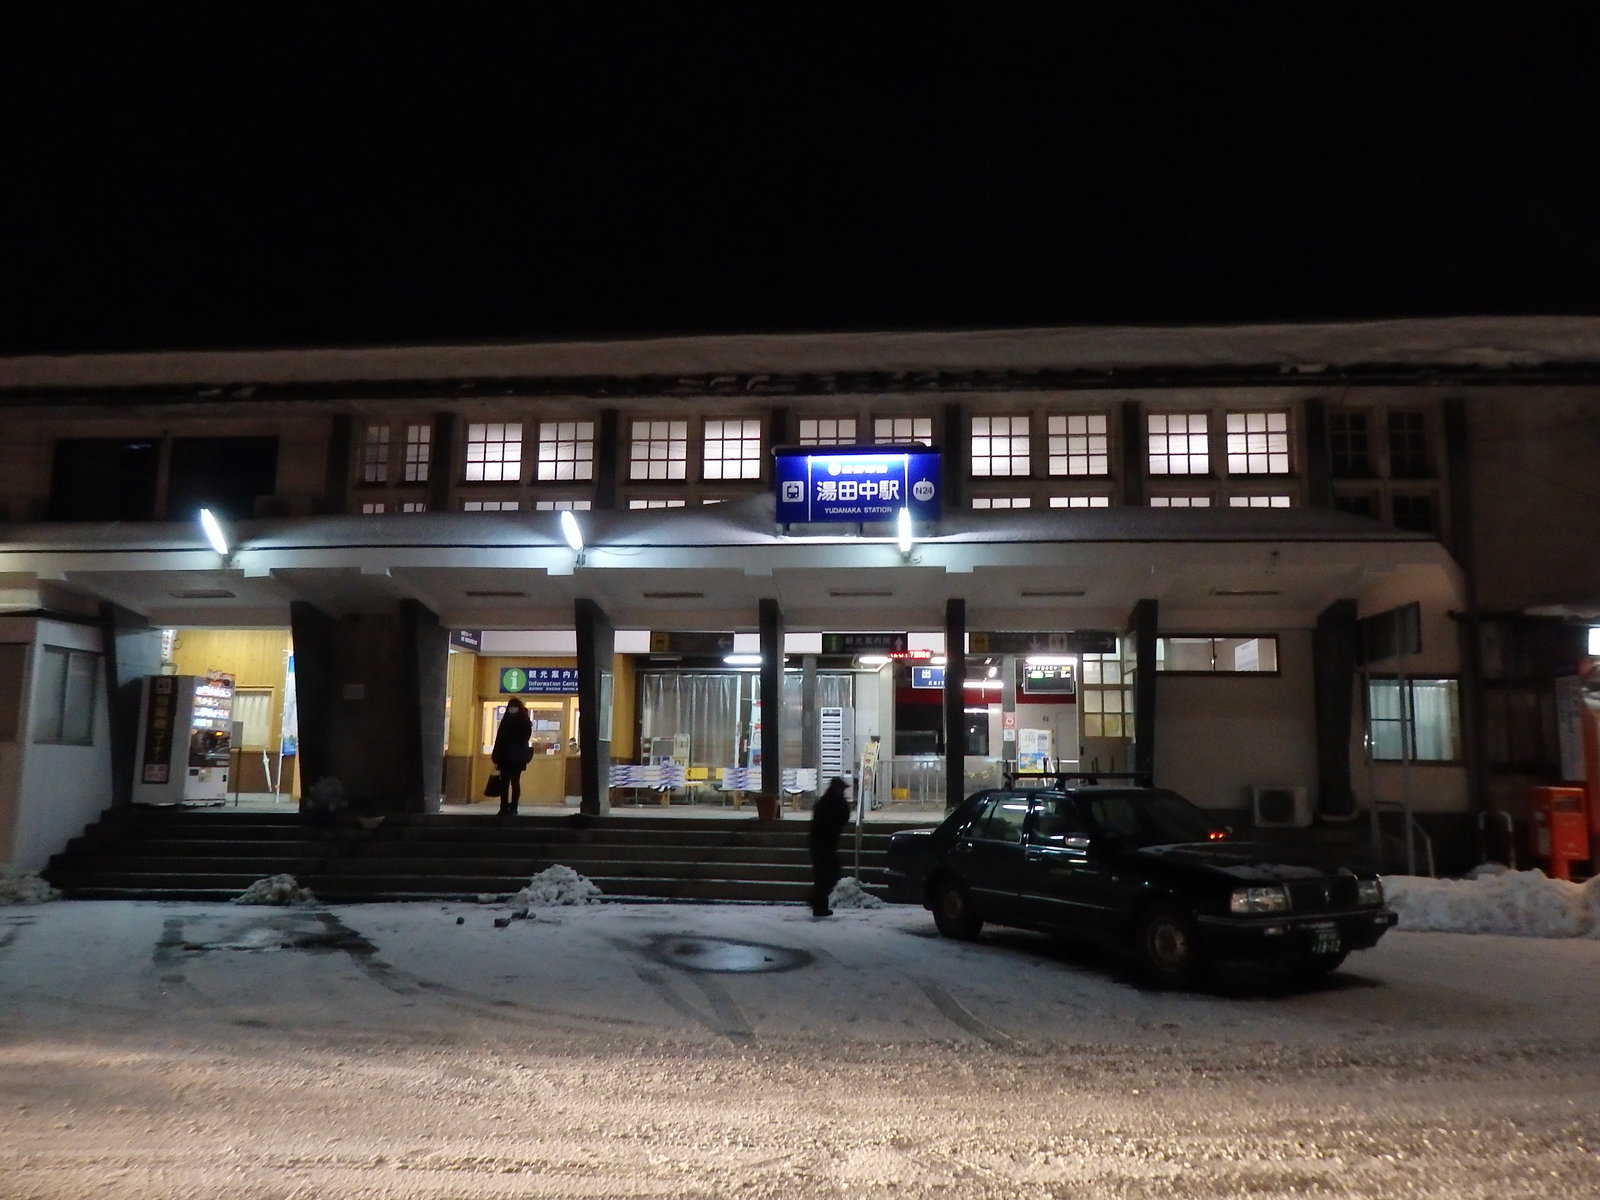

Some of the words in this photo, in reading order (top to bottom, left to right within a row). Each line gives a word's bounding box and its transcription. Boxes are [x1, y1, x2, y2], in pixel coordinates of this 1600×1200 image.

[816, 480, 900, 501] 湯田中駅
[915, 486, 933, 495] N24
